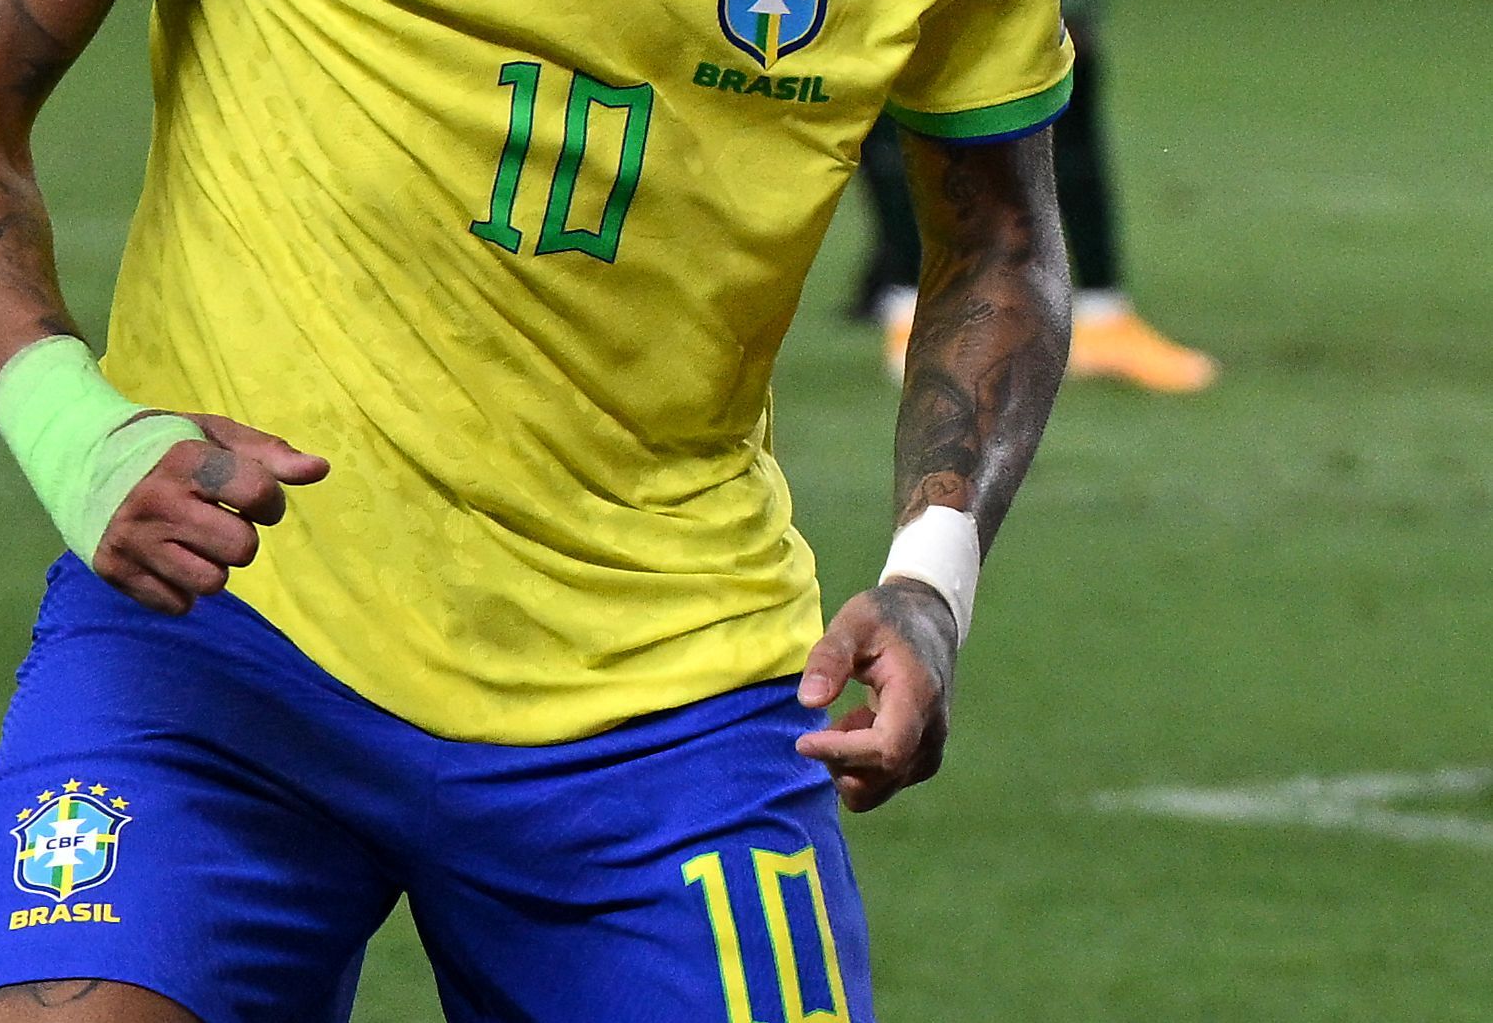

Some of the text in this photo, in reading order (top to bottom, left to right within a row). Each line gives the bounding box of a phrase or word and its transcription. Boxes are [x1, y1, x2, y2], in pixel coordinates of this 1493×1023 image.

[692, 61, 831, 103] BRASIL
[469, 60, 654, 263] 10
[45, 835, 85, 850] CBF
[9, 903, 121, 931] BRASIL
[680, 843, 850, 1023] 10
